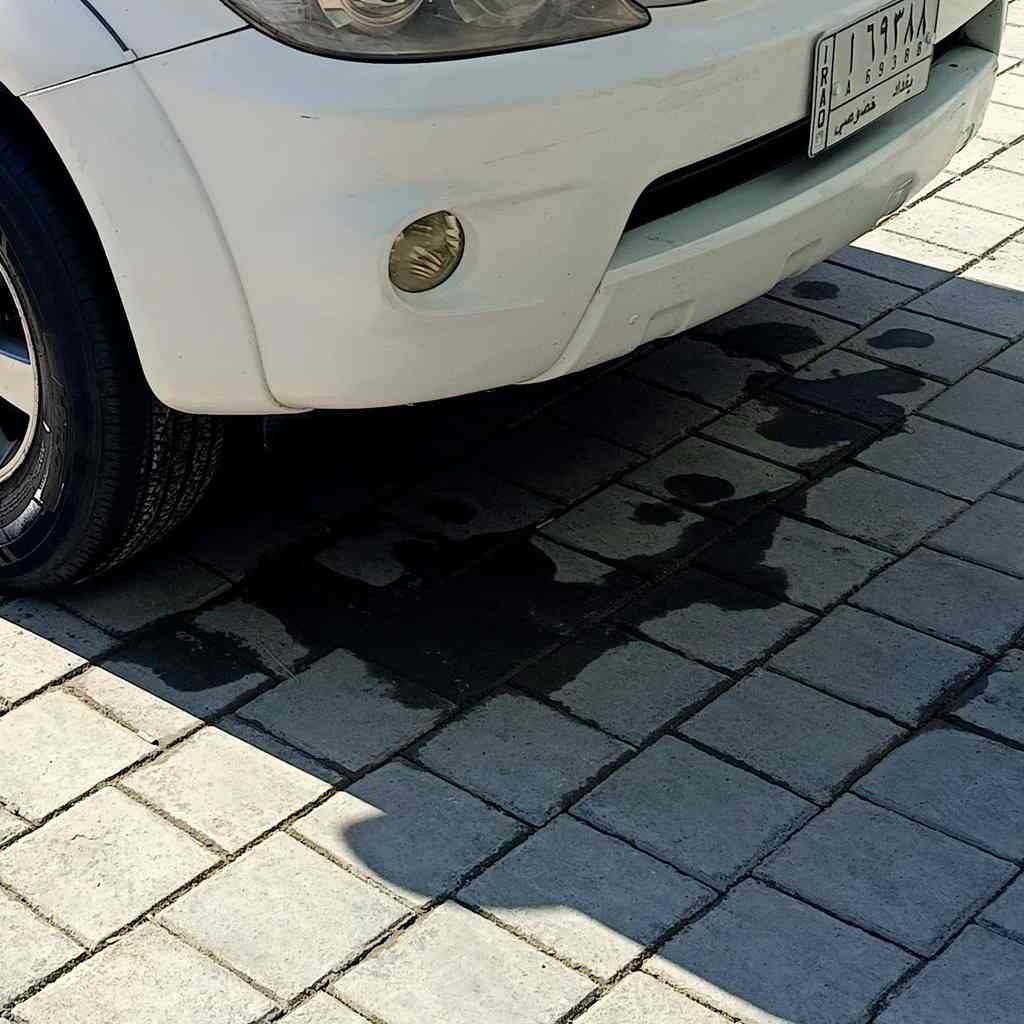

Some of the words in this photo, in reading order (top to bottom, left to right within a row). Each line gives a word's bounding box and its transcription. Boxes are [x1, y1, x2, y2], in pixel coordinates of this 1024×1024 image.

[817, 44, 829, 129] IRAQ
[892, 73, 914, 98] بغداد
[834, 96, 876, 136] خصوصي
